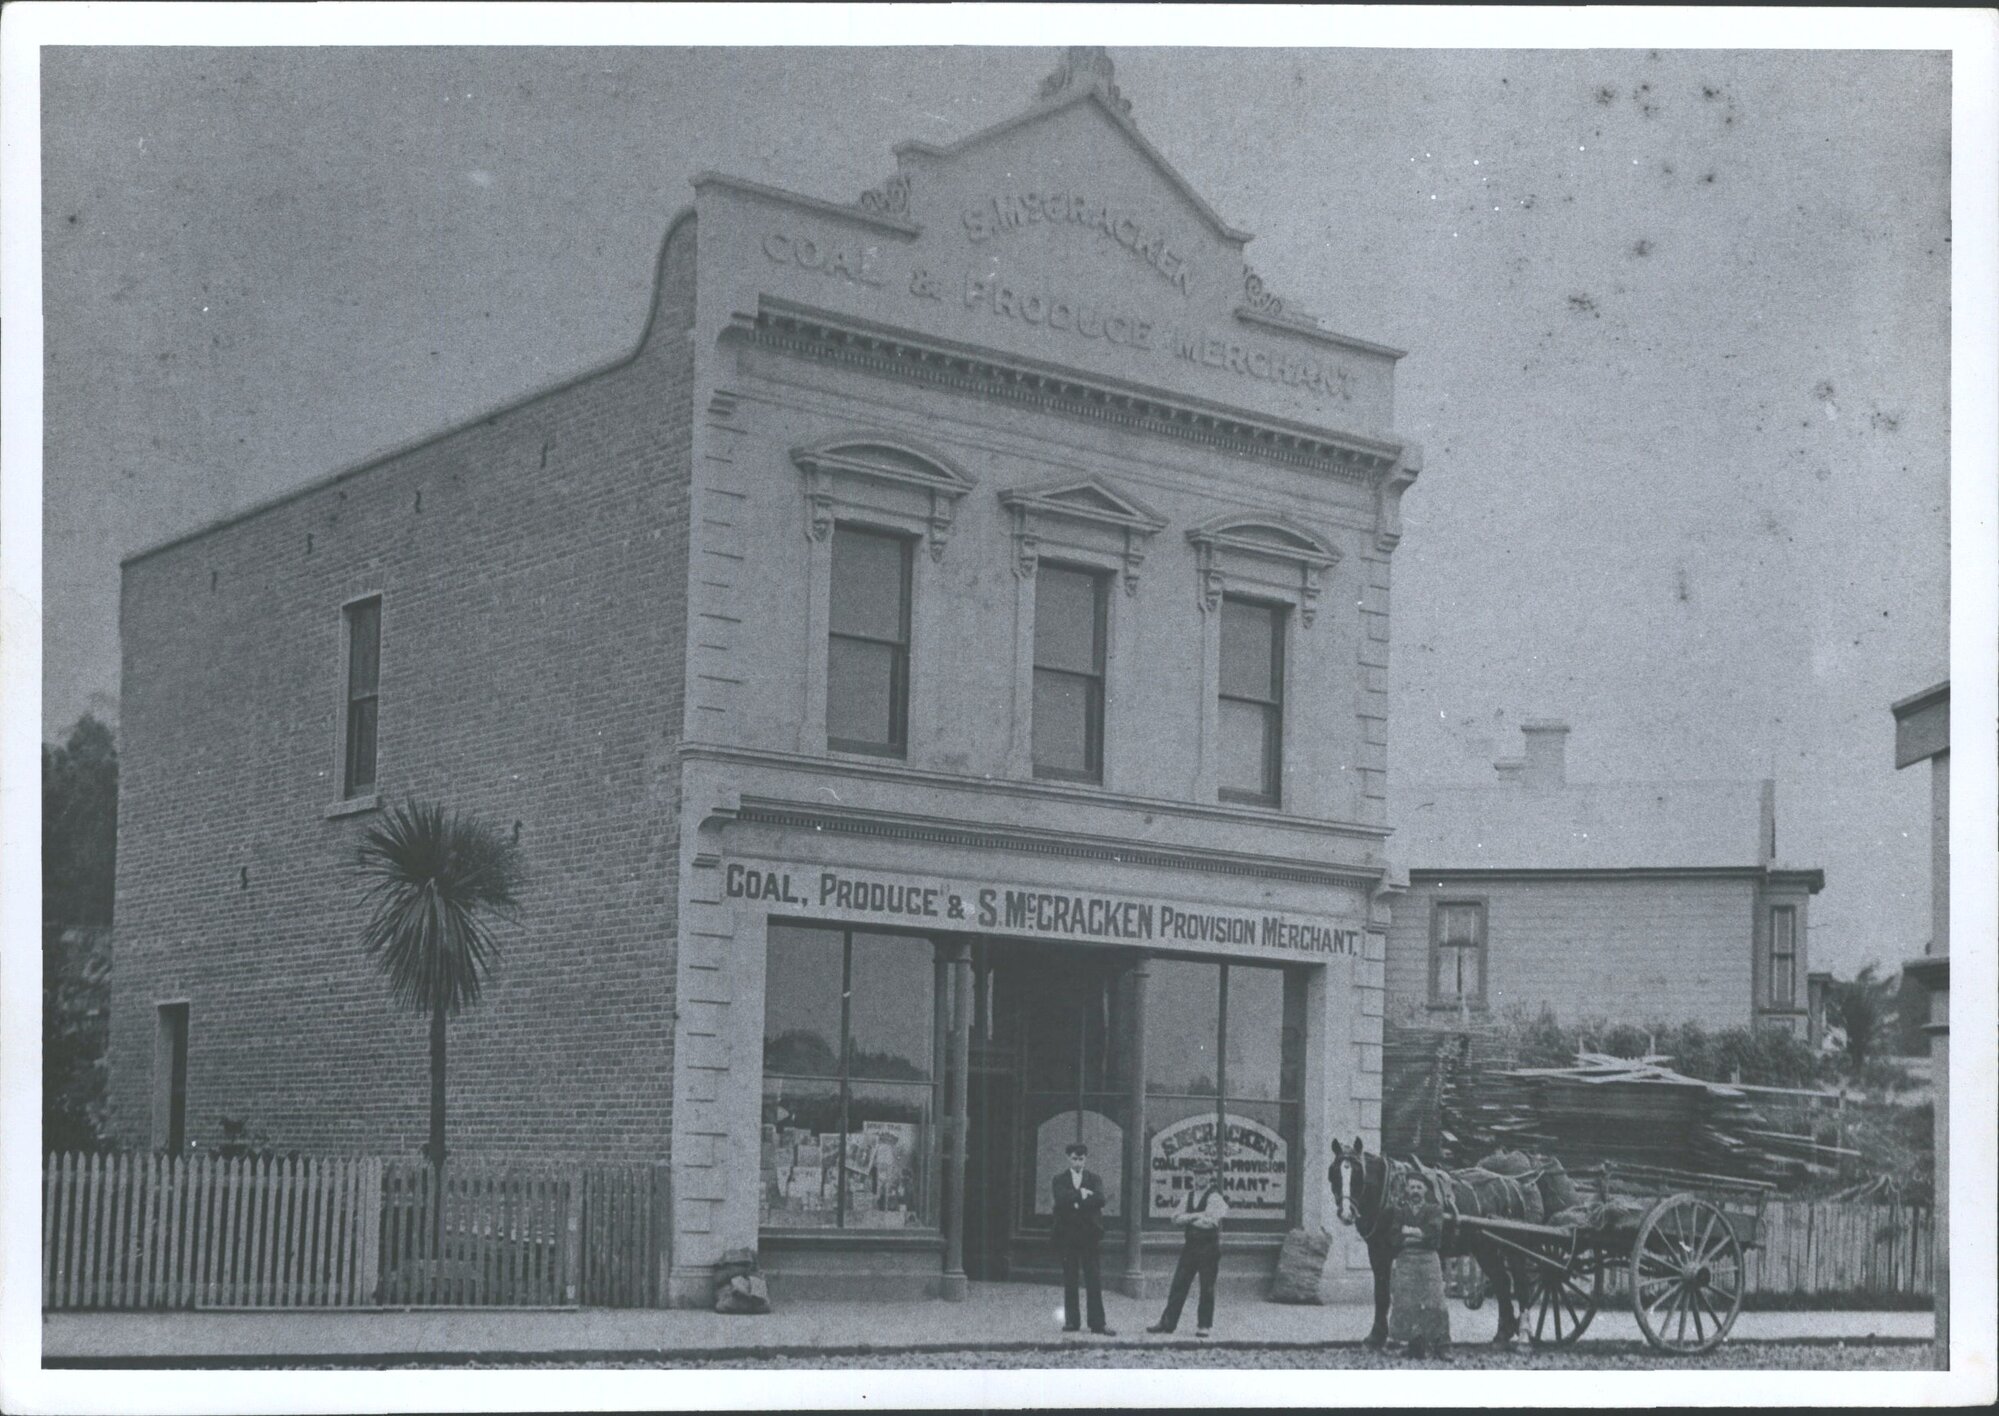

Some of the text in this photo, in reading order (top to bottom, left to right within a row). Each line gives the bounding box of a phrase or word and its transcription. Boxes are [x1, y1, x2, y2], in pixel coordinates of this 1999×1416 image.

[762, 232, 1354, 401] COAL & PRODUCE MERCHANT
[819, 873, 939, 917] PRODUCE
[947, 894, 965, 920] &
[1160, 905, 1255, 945] PROVISION
